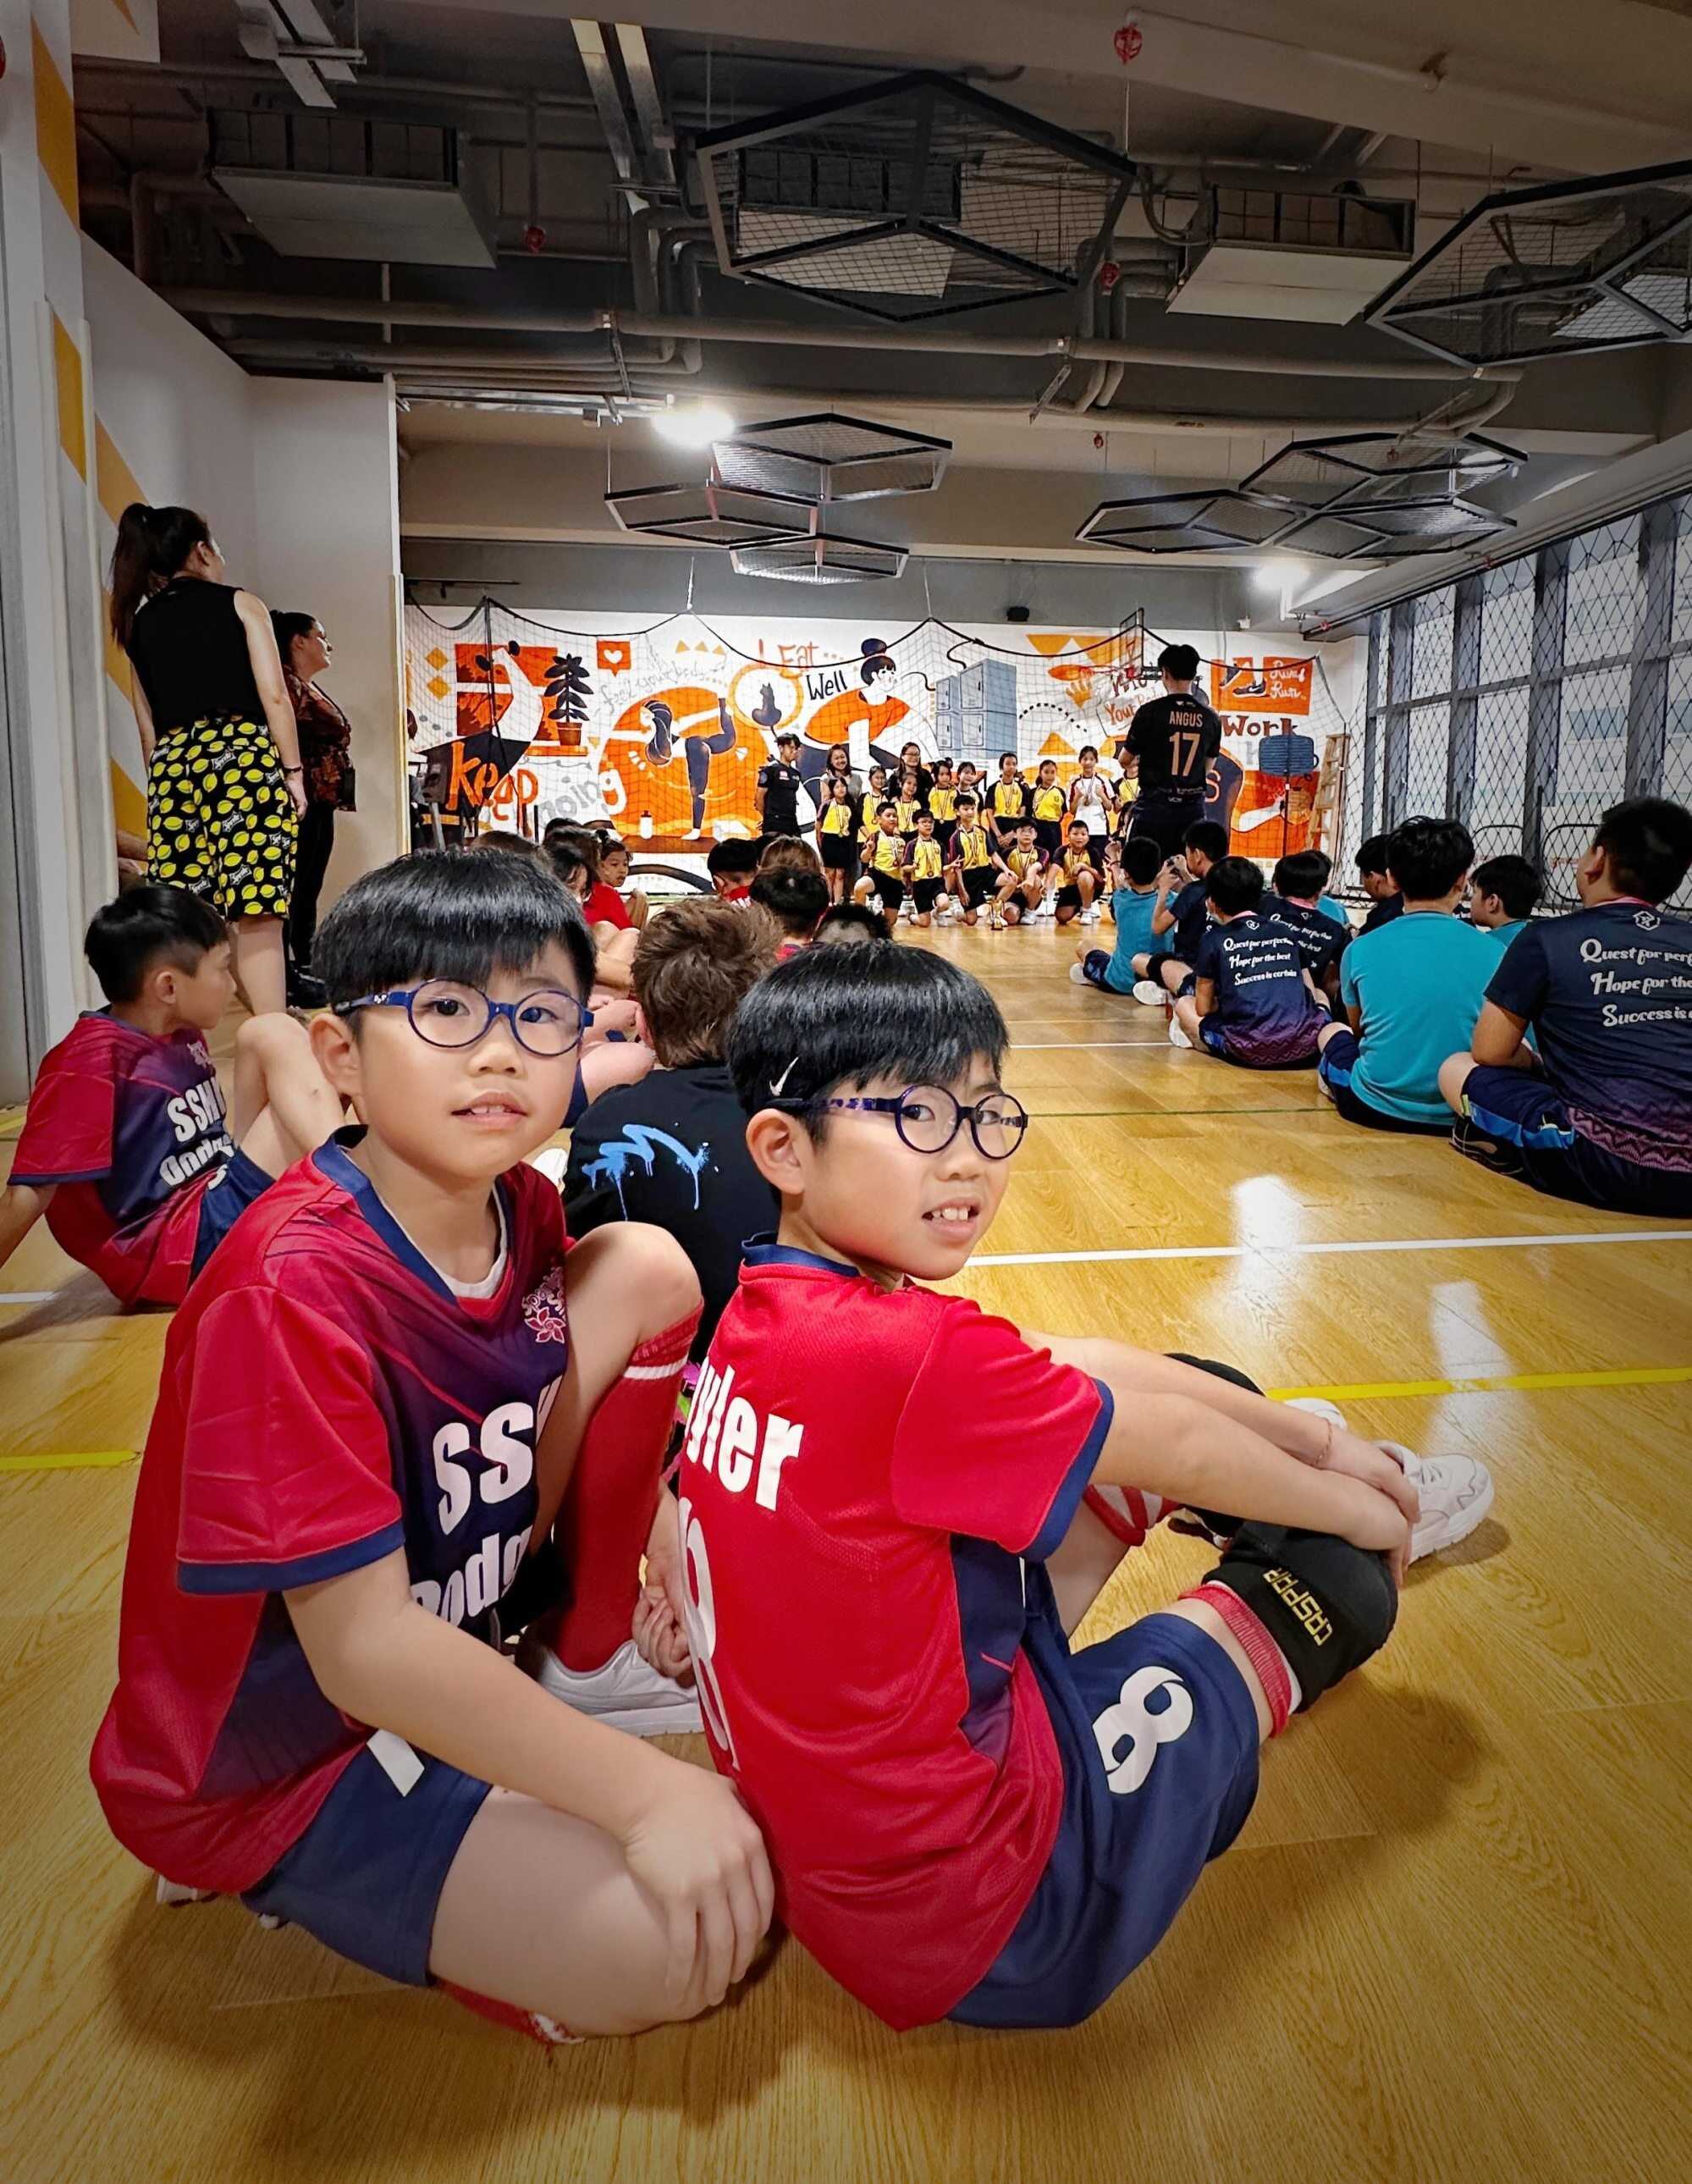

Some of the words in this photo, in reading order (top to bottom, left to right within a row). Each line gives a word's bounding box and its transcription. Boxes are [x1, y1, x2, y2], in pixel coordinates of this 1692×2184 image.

[807, 670, 848, 701] Well
[1169, 710, 1203, 727] ANGUS
[1220, 715, 1298, 737] Work
[1169, 731, 1201, 777] 17
[1223, 937, 1249, 951] Quest
[1579, 938, 1637, 962] Quest
[1635, 948, 1662, 965] for
[1229, 953, 1251, 969] Hope
[1276, 952, 1291, 961] best
[1234, 972, 1265, 985] Success
[1590, 970, 1642, 995] Hope
[1641, 979, 1669, 995] for
[1601, 1004, 1673, 1028] Success
[1673, 1006, 1686, 1019] is
[1263, 1568, 1333, 1646] CASPAR
